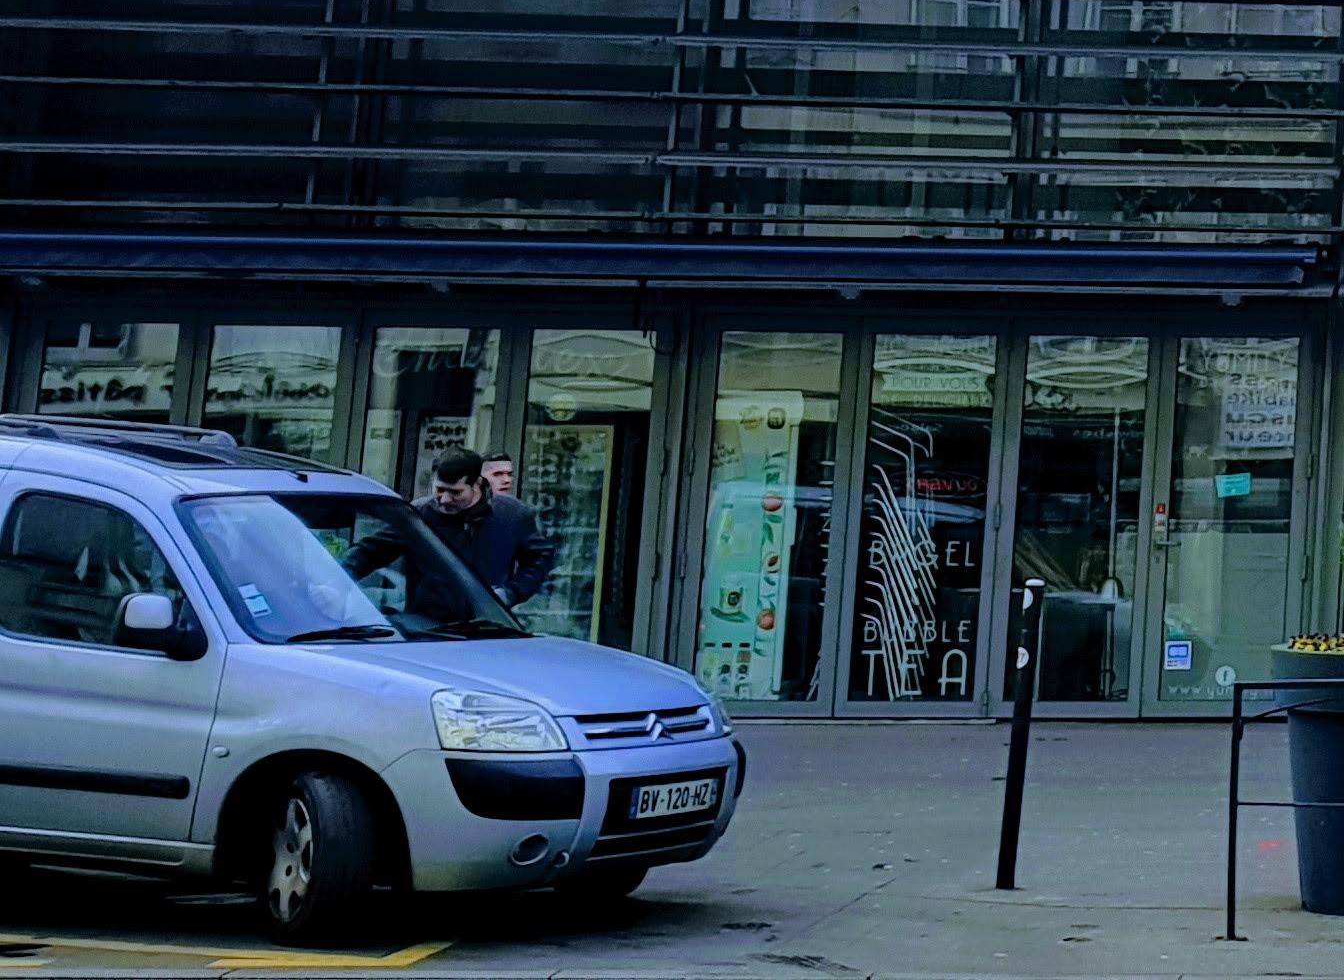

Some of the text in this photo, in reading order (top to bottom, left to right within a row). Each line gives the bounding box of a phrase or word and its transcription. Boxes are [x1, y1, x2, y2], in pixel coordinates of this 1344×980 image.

[868, 540, 976, 567] BAGEL
[863, 620, 972, 643] BUBBLE
[861, 648, 969, 697] TEA
[640, 783, 711, 814] BV-120-HZ
